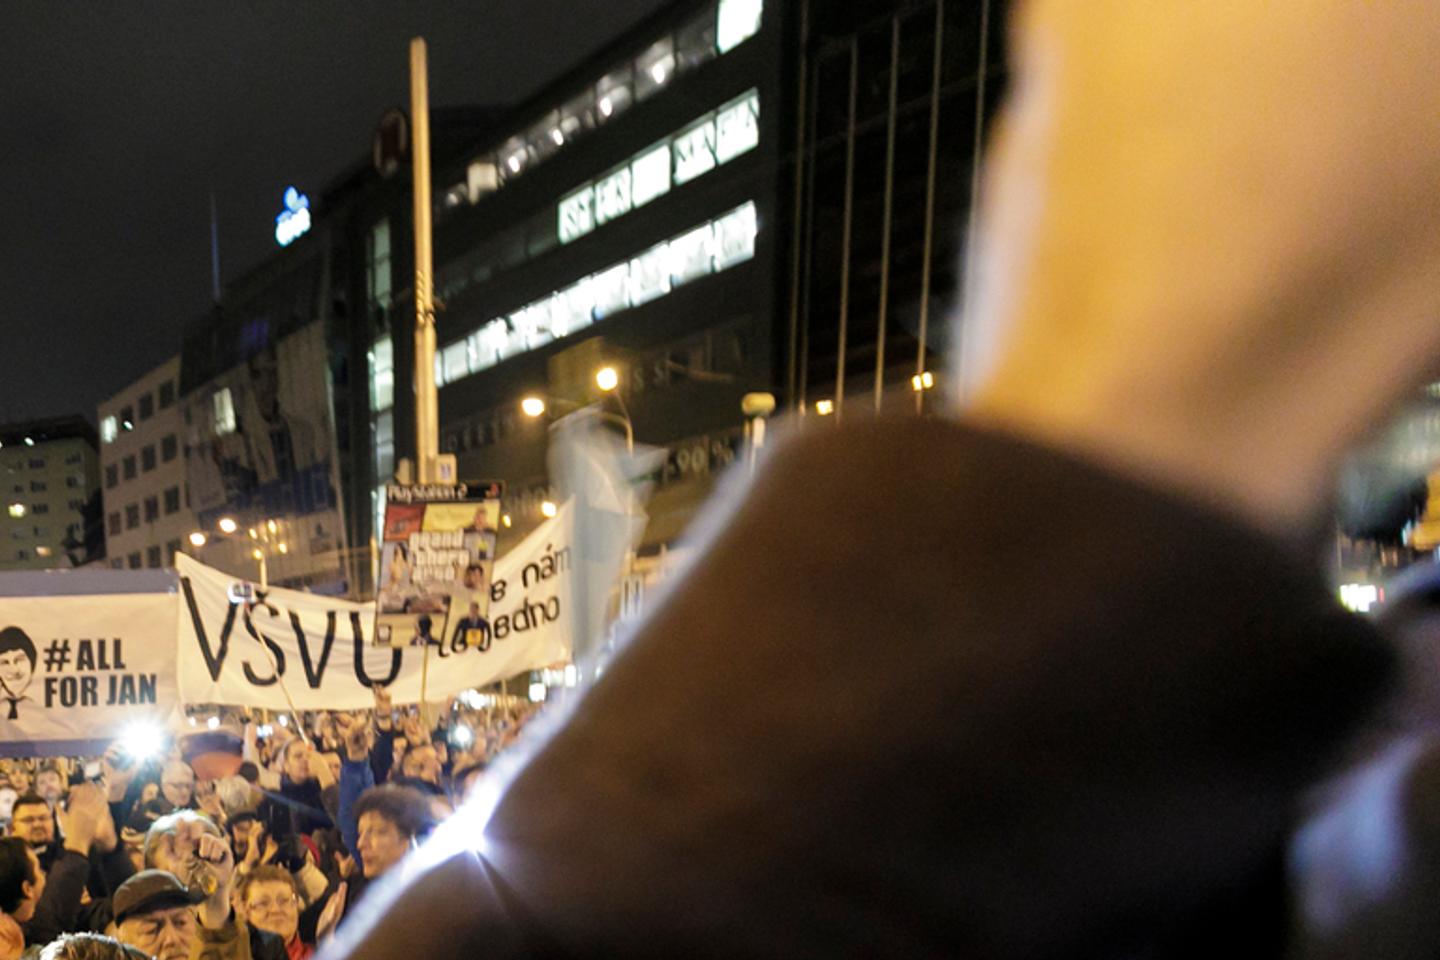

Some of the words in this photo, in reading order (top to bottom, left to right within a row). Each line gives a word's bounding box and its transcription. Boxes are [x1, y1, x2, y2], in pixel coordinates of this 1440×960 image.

[180, 576, 403, 689] VŠVU
[43, 637, 126, 672] #ALL
[45, 675, 98, 708] FOR
[106, 673, 157, 705] JAN
